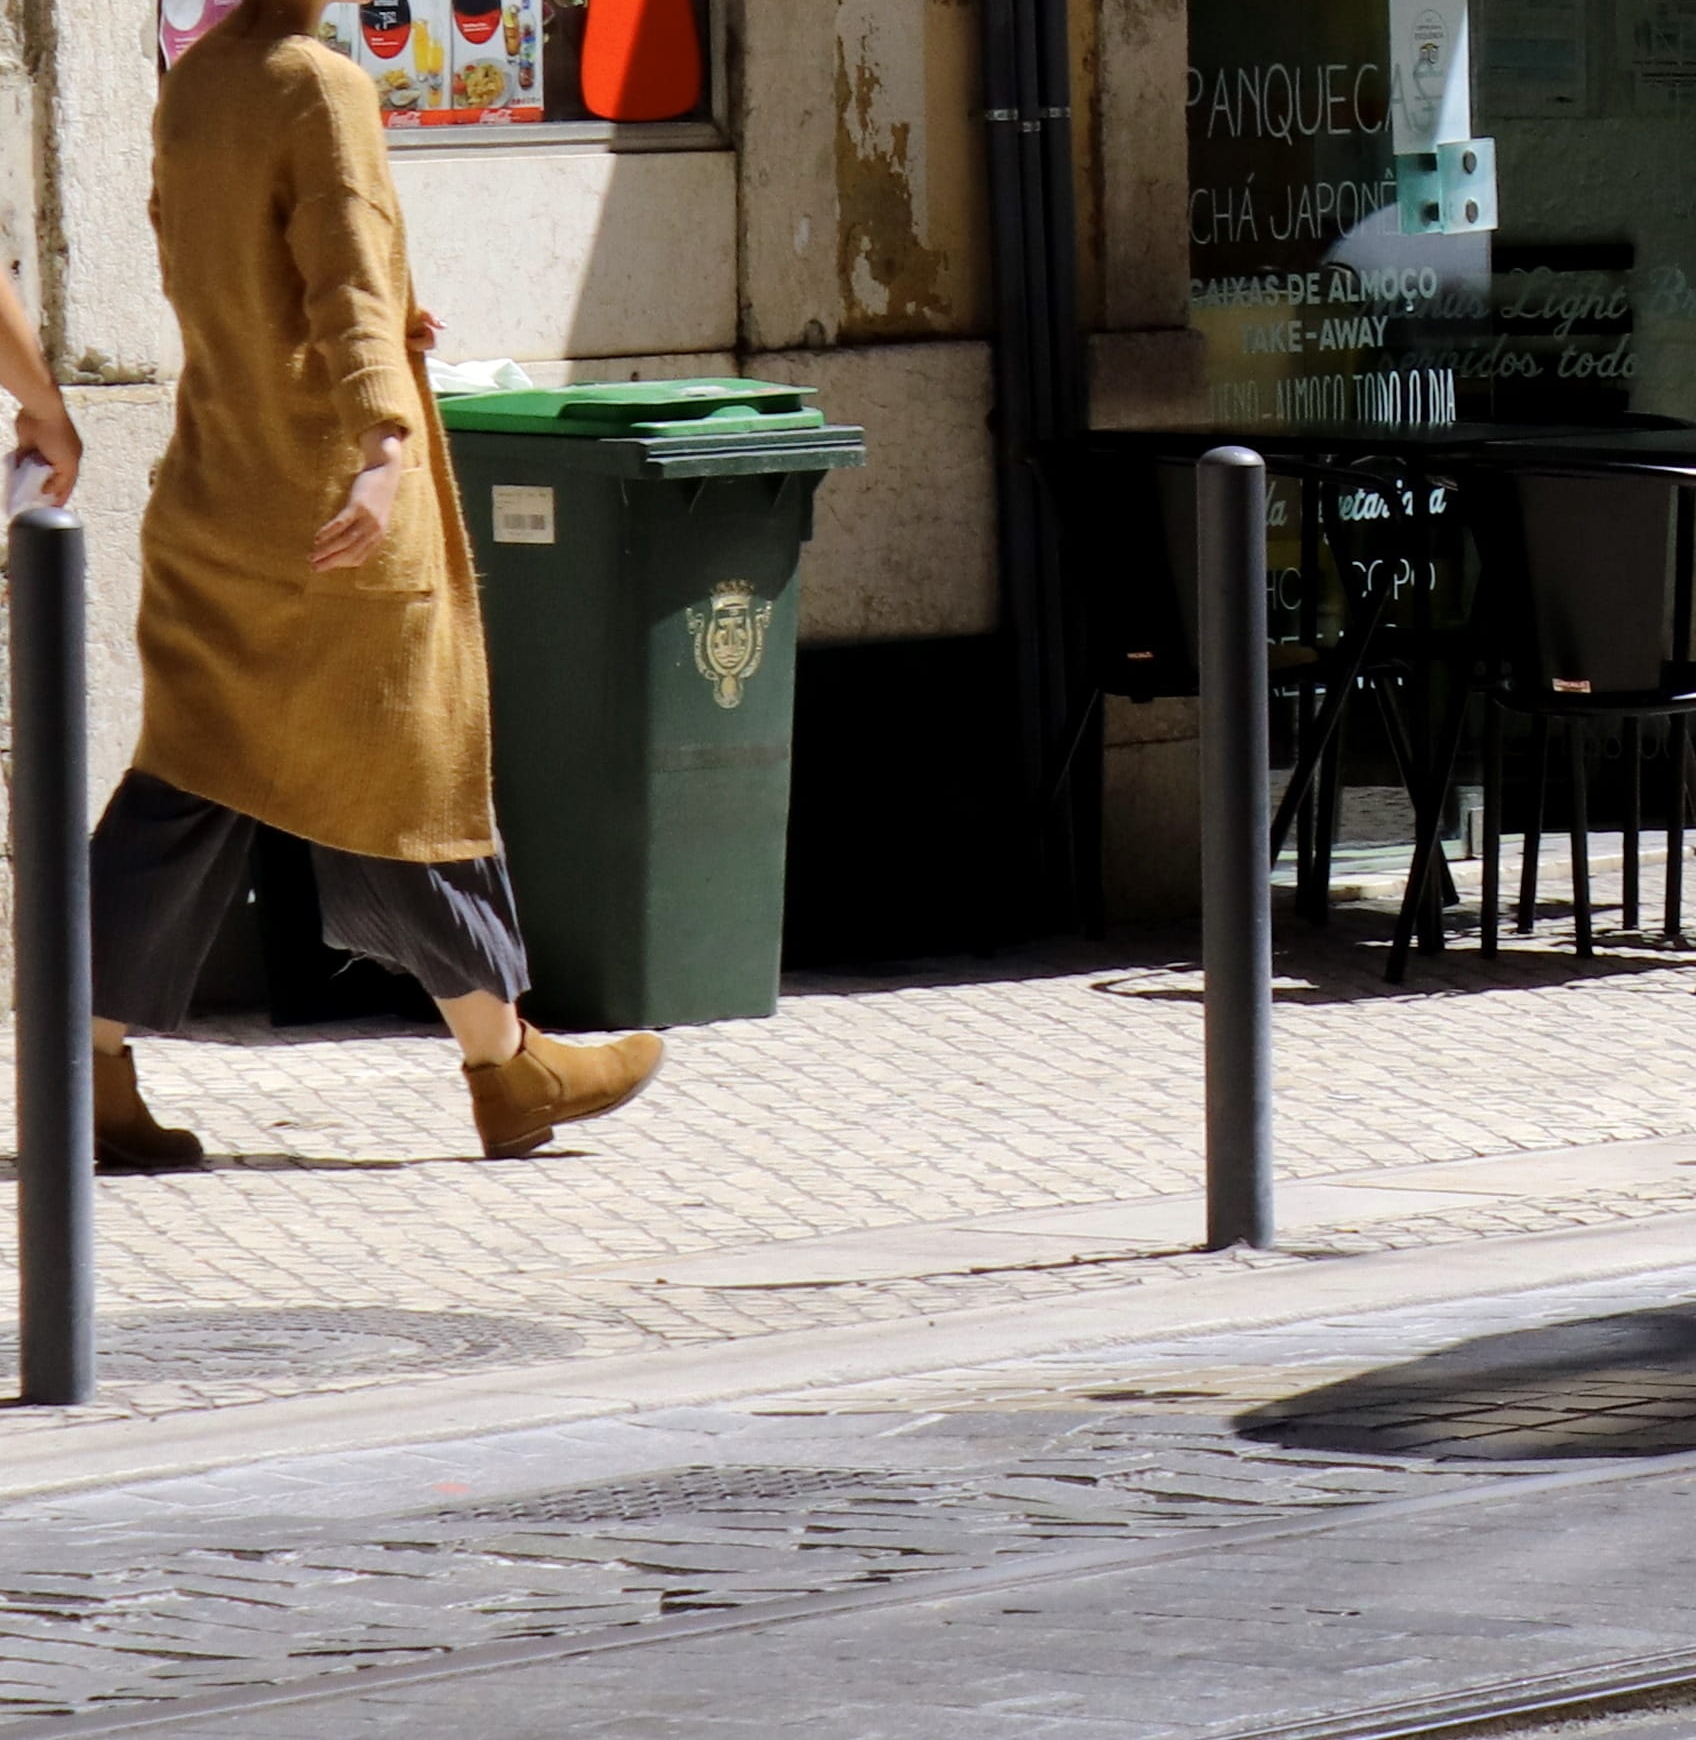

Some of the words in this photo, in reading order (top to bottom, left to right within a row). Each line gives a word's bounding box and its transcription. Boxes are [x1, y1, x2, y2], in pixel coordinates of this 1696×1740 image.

[1189, 171, 1259, 246] CHÁ
[1269, 166, 1399, 241] JAPONÊ
[1286, 271, 1321, 306] DE
[1327, 266, 1438, 313] ALMOÇO
[1242, 315, 1390, 355] TAKE-AWAY
